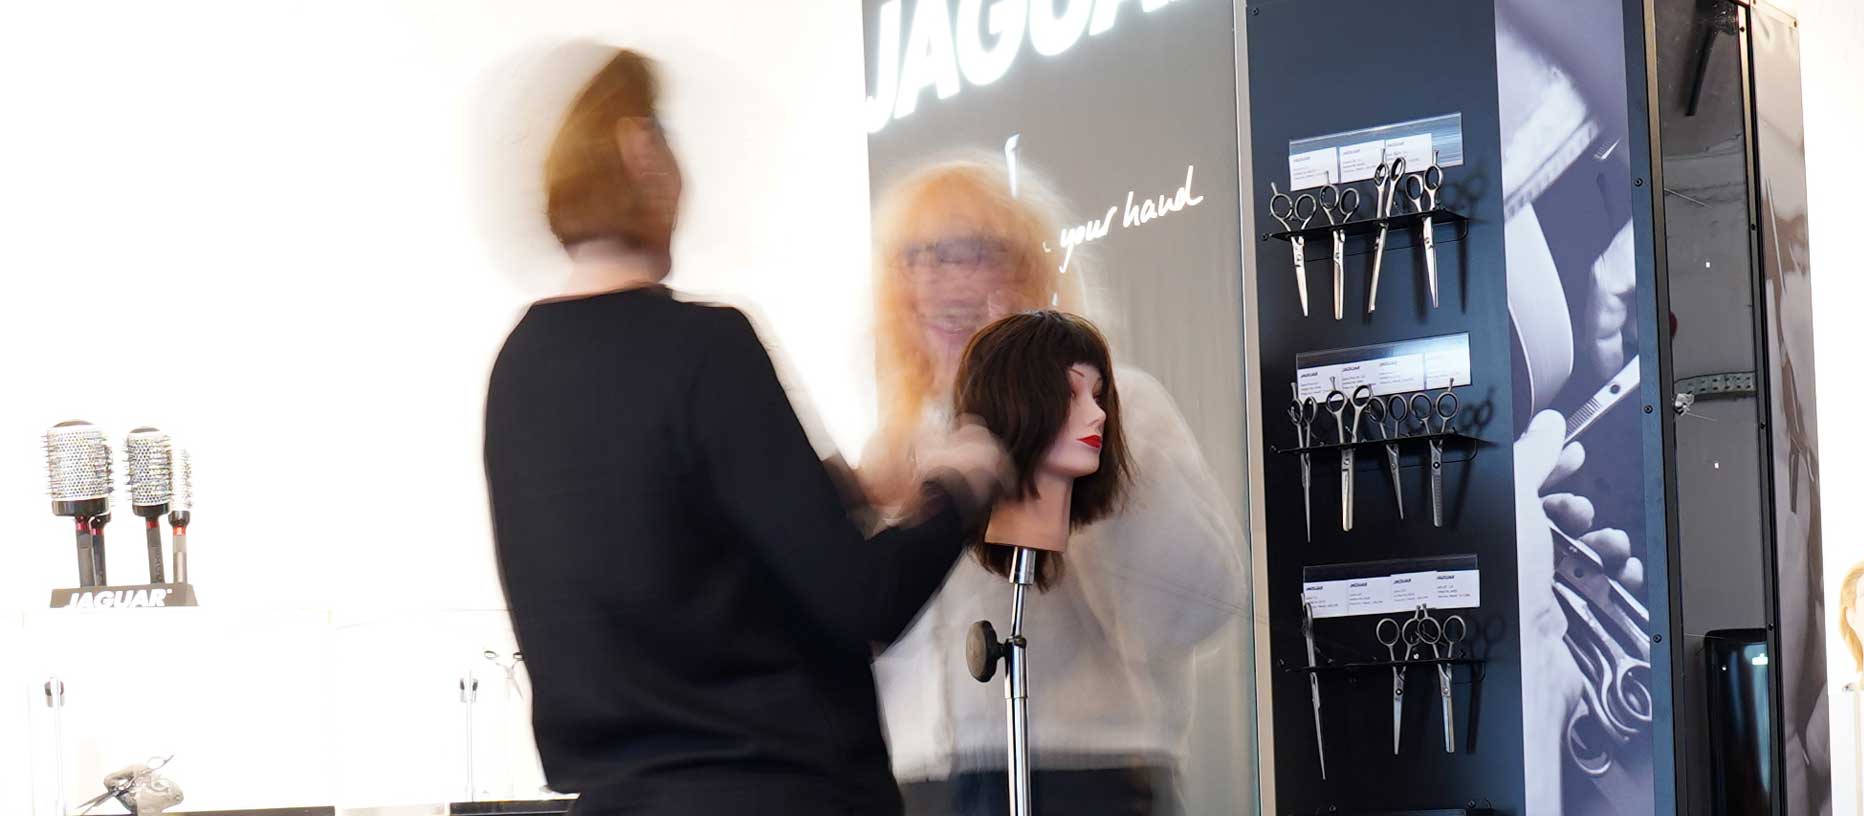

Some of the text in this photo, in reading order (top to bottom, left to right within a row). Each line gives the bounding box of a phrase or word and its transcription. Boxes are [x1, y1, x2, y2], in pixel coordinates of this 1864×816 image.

[864, 0, 1181, 133] JAGU
[1059, 165, 1204, 273] your hand
[64, 588, 167, 608] JAGUAR
